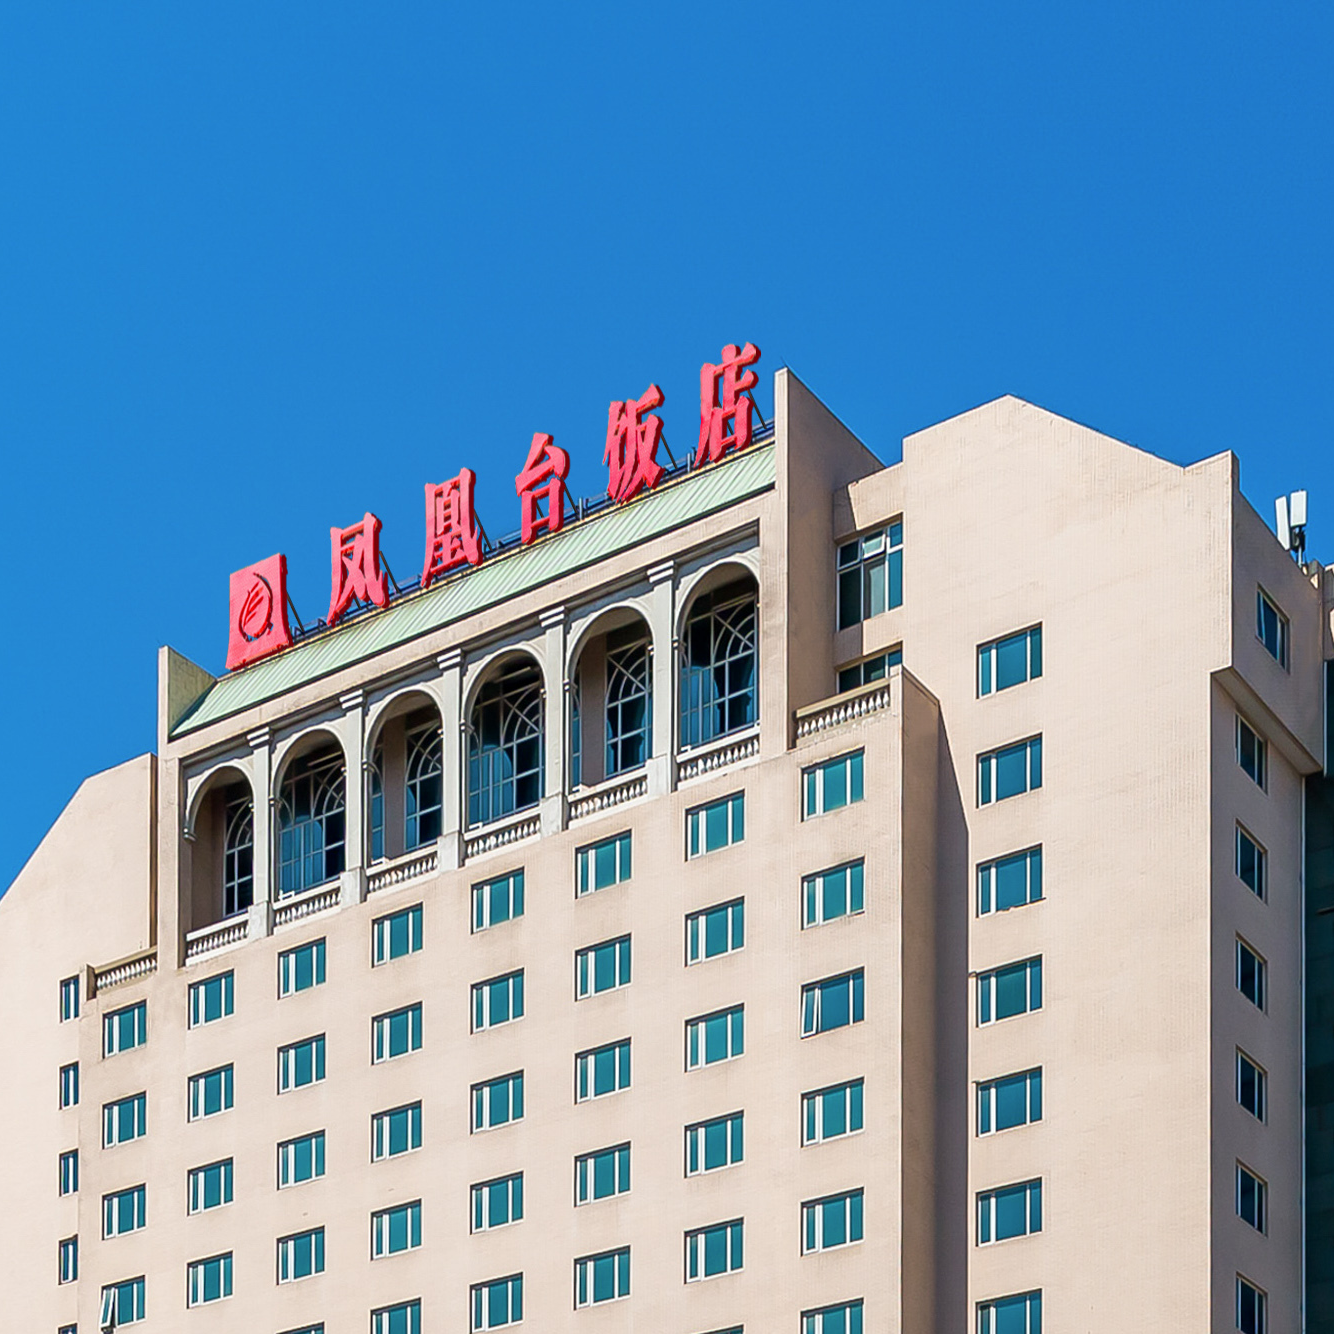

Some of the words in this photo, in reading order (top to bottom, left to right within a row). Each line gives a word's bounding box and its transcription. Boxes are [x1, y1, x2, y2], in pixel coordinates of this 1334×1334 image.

[327, 341, 762, 627] 凤凰台饭店
